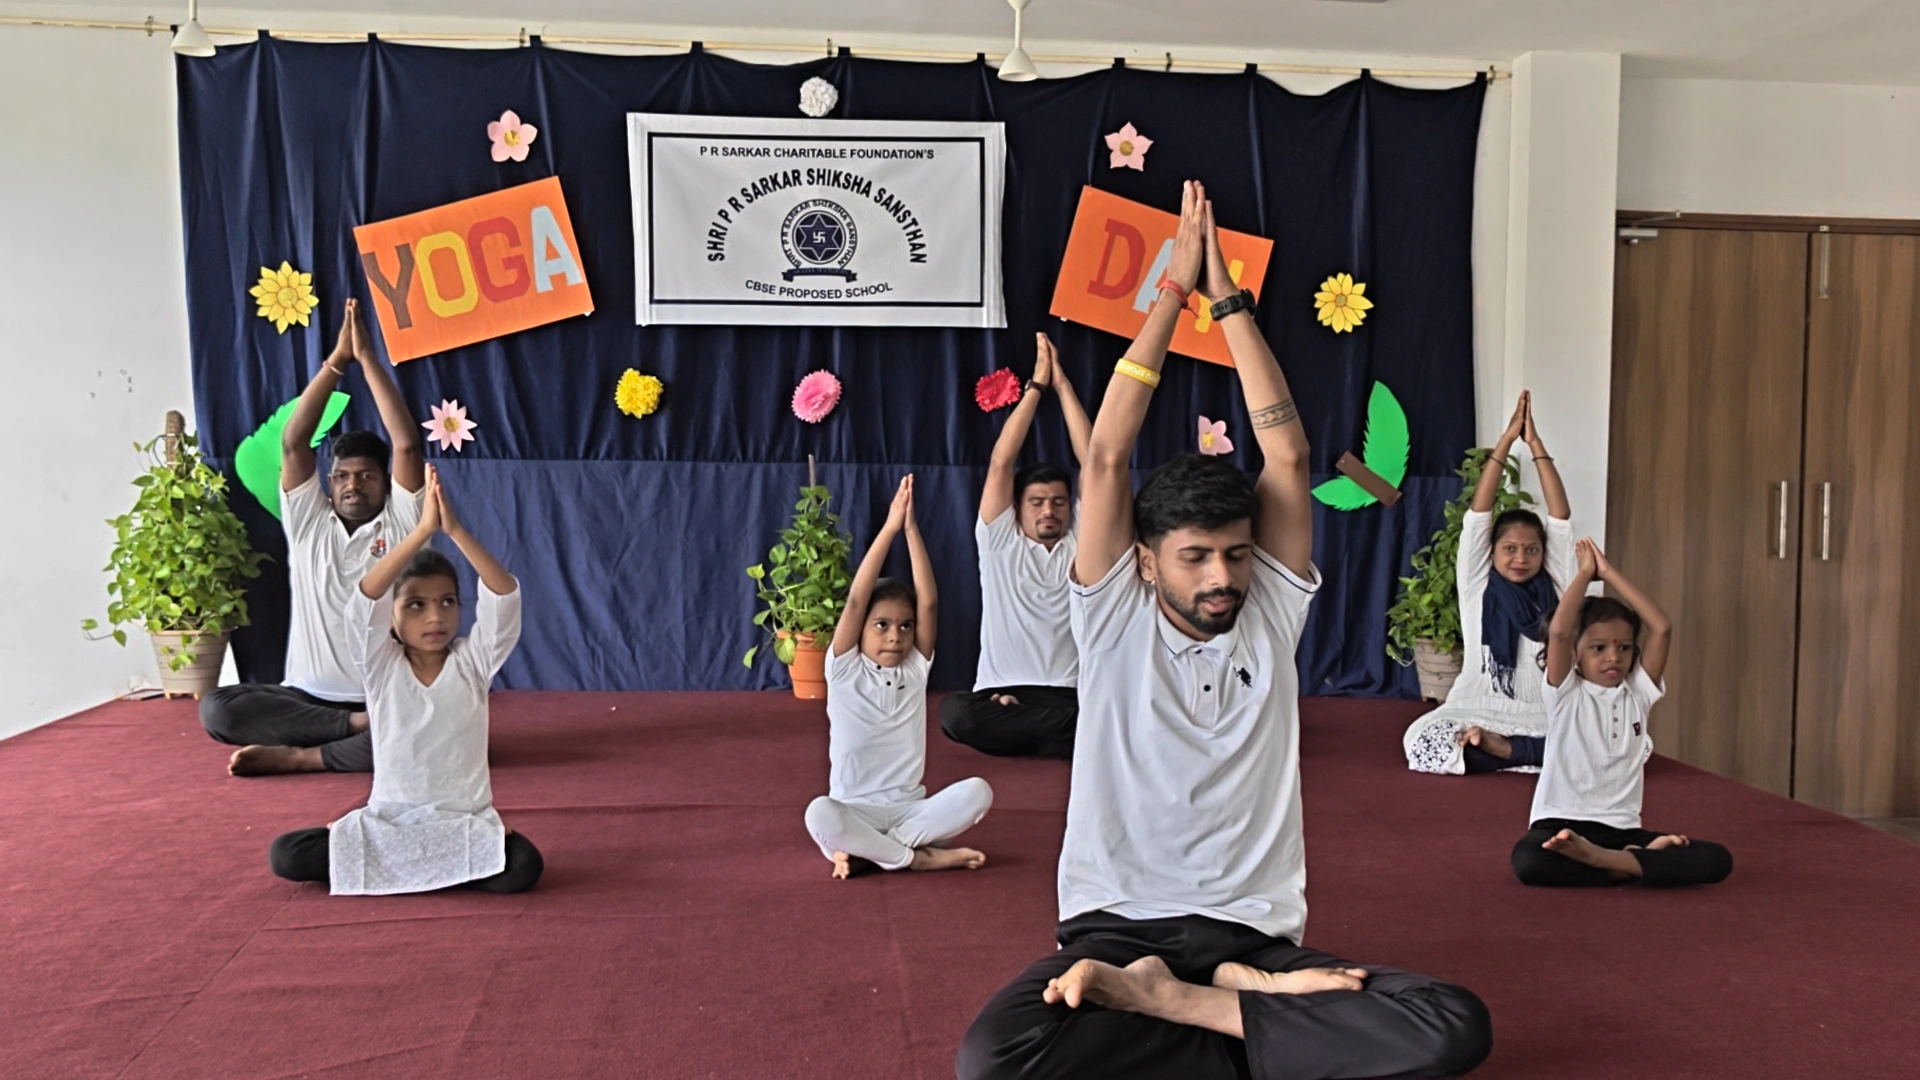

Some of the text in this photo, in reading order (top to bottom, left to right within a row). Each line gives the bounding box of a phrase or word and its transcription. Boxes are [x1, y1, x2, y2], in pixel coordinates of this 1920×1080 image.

[700, 146, 934, 160] P R SARKAR CHARITABLE FOUNDATION'S
[707, 168, 928, 264] SHRI P R SARKAR SHIKSHA SANSTHAN
[784, 202, 811, 229] SARKAR
[812, 200, 849, 221] SHIKSHA
[837, 221, 857, 267] SANSTHAN
[361, 205, 585, 330] YOGA
[745, 279, 893, 300] CBSE PROPOSED SCHOOL
